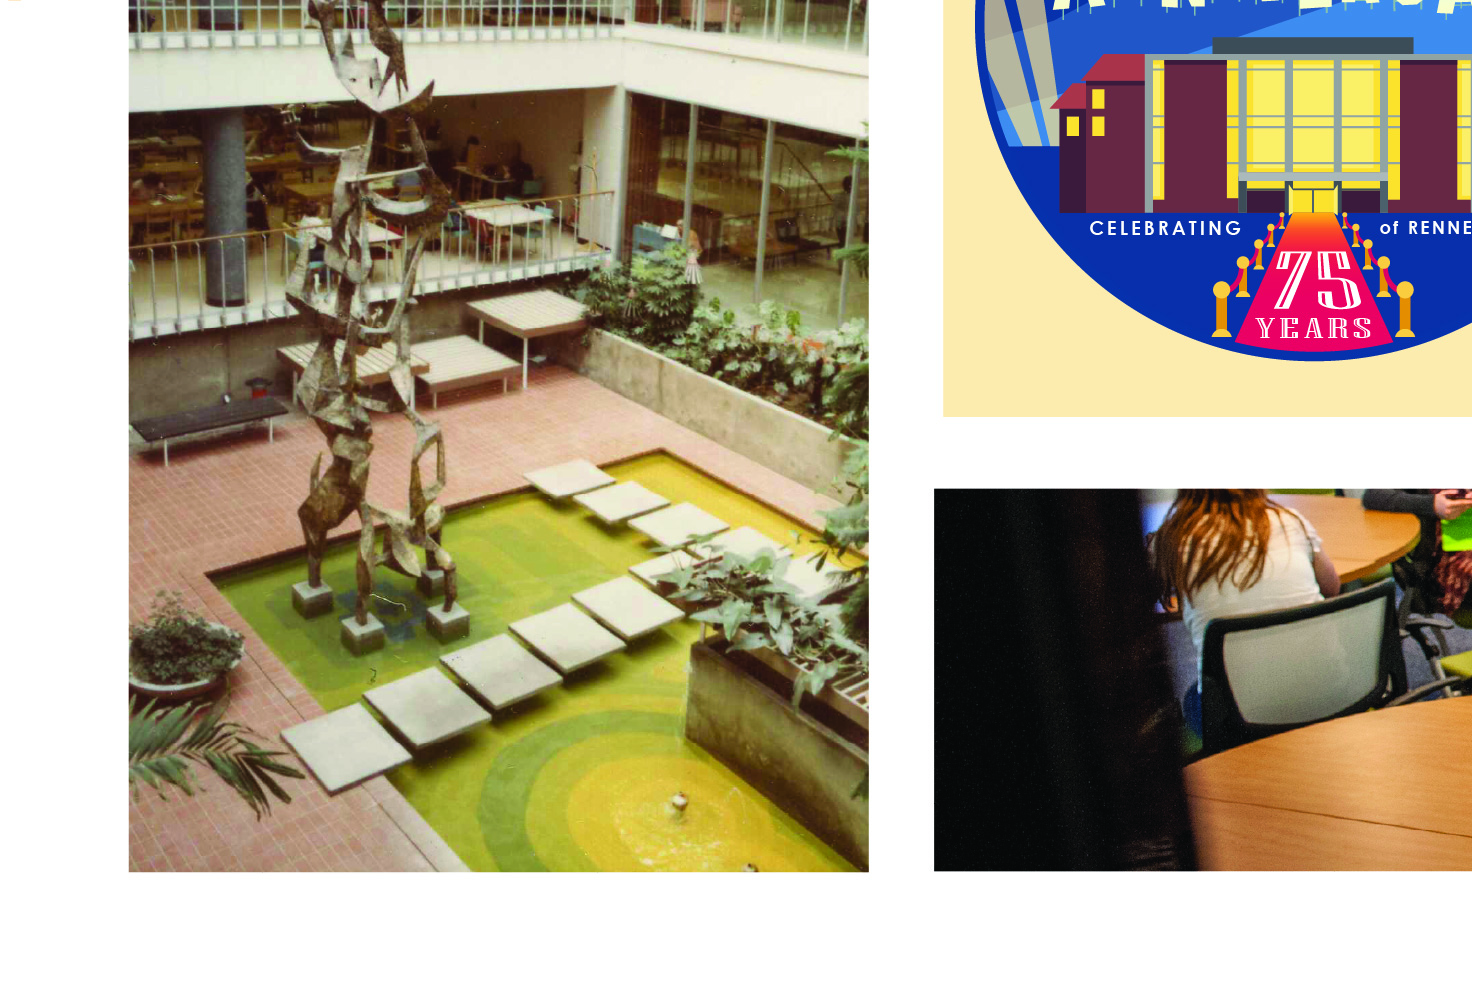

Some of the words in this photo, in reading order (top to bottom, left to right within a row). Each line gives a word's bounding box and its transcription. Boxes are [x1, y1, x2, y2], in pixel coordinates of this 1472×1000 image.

[1090, 221, 1241, 235] CELEBRATING
[1380, 221, 1399, 235] of
[1409, 221, 1472, 235] RENNE
[1274, 251, 1362, 310] 75
[1255, 318, 1371, 339] YEARS
